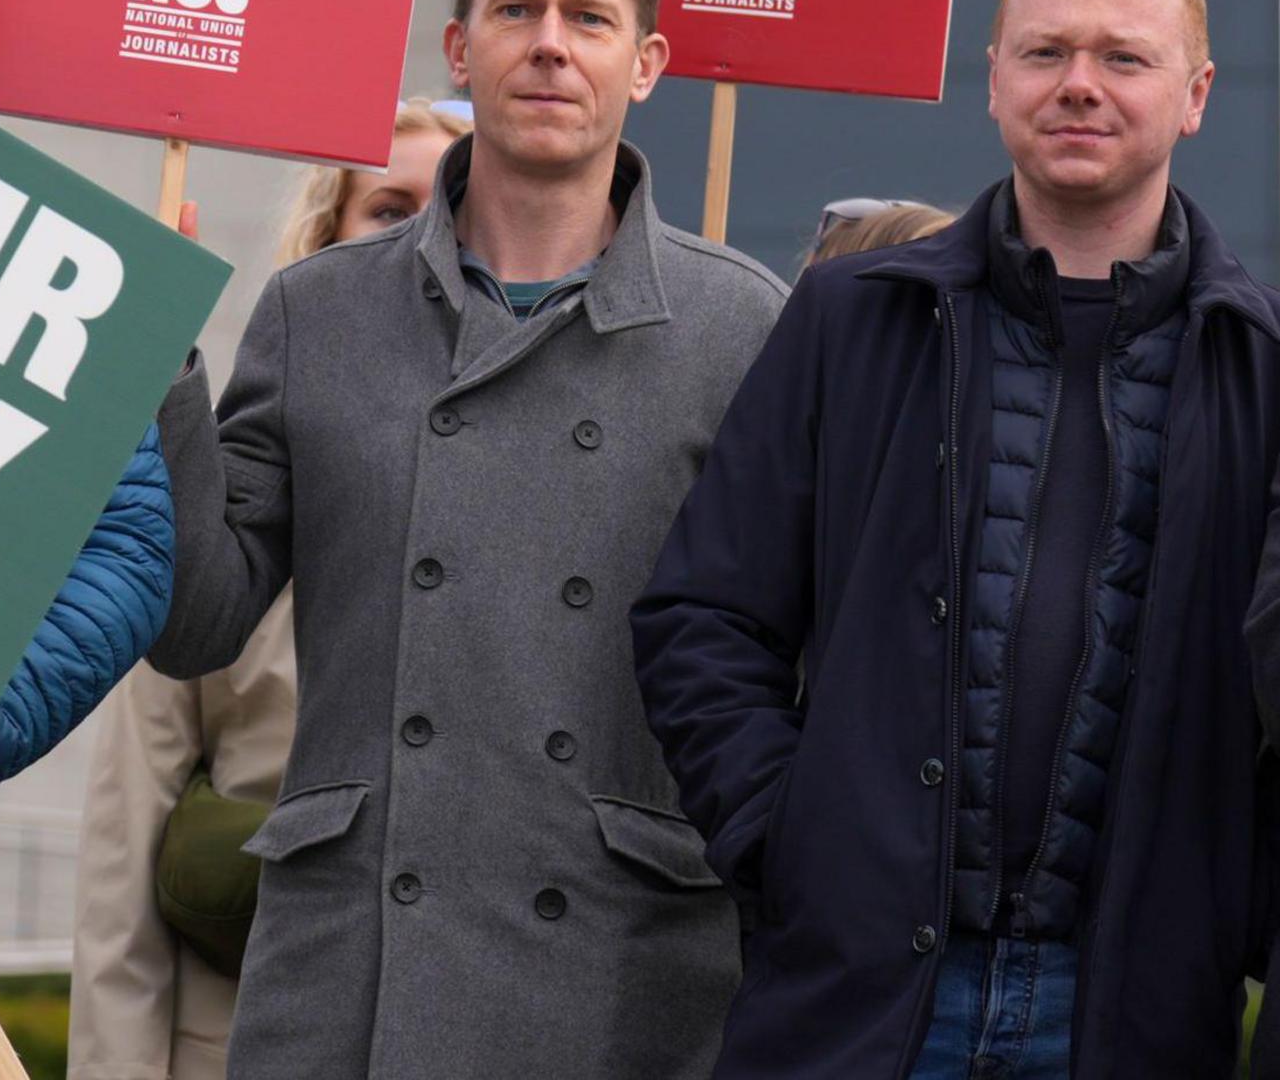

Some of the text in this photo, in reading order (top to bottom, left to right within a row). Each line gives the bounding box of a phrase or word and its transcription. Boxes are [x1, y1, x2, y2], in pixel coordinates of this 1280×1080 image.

[124, 8, 245, 37] NATIONAL UNION
[120, 34, 240, 65] JOURNALISTS
